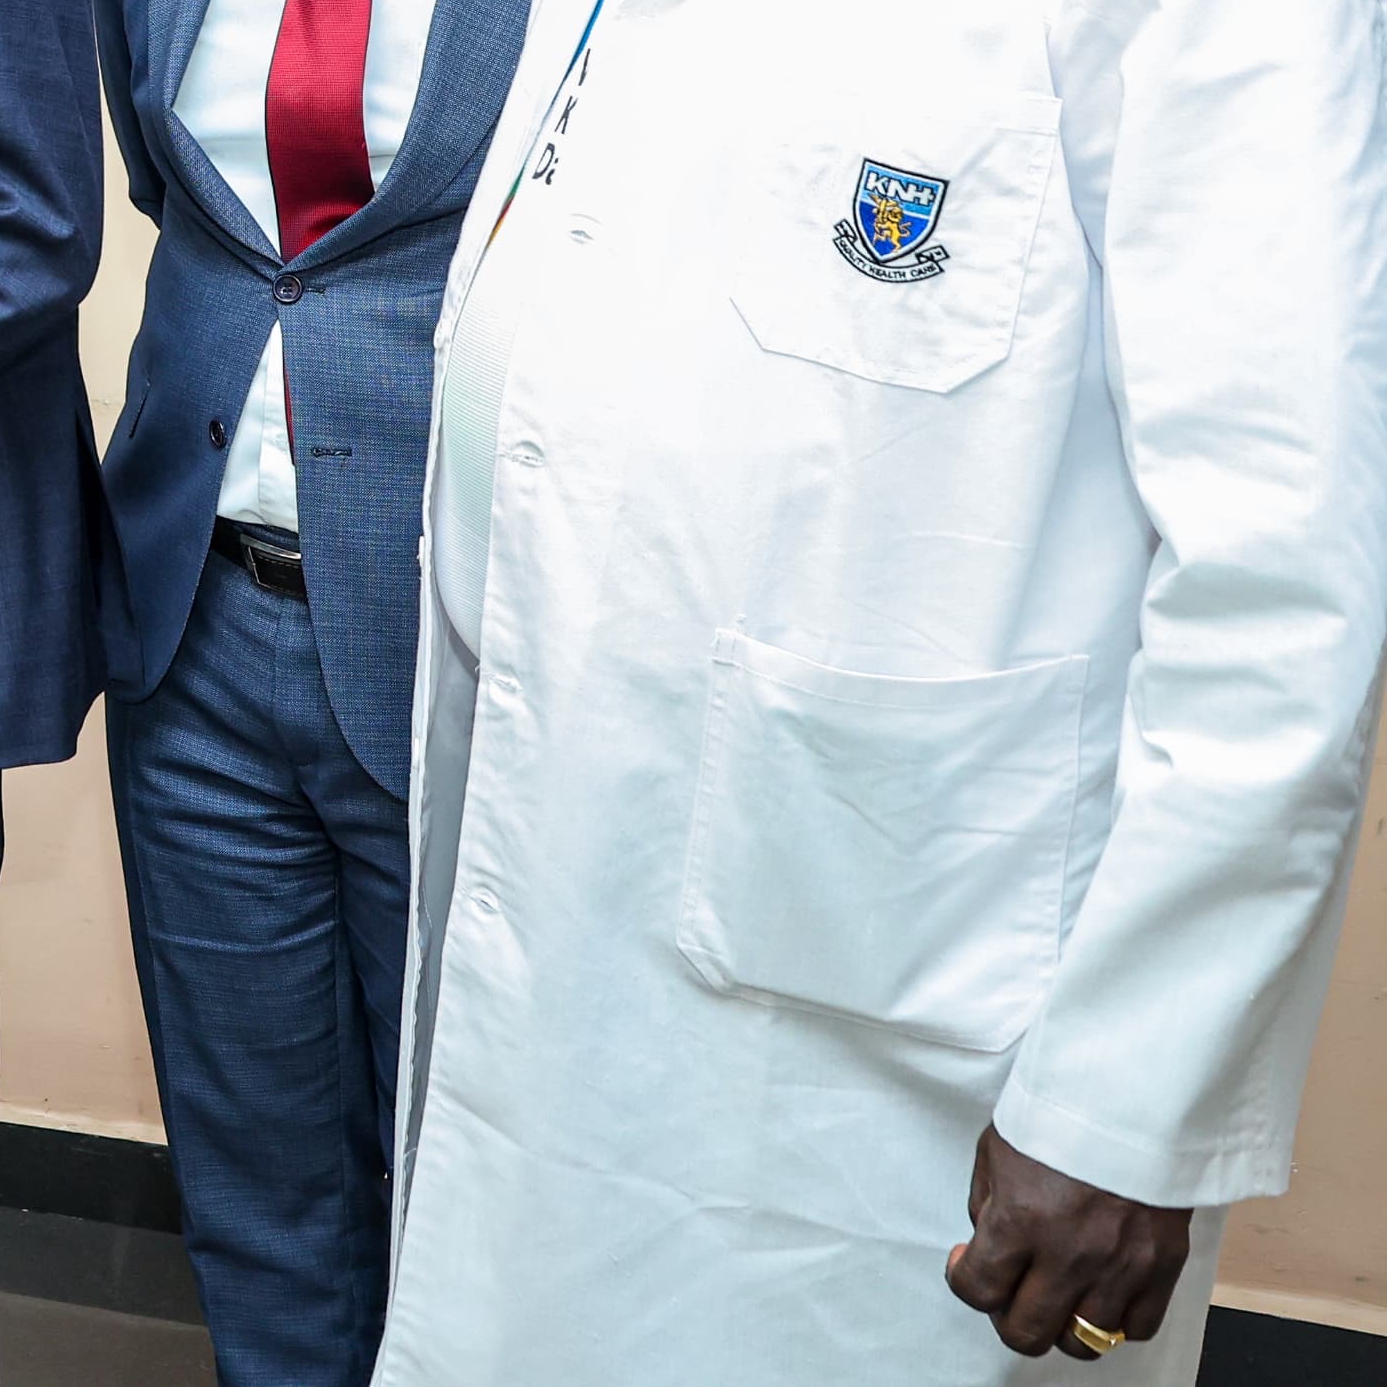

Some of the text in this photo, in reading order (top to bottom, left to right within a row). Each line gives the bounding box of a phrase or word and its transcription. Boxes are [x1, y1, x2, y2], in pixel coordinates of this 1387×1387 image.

[867, 173, 935, 206] KNH
[838, 239, 938, 279] QUALITY HEALTH CARE
